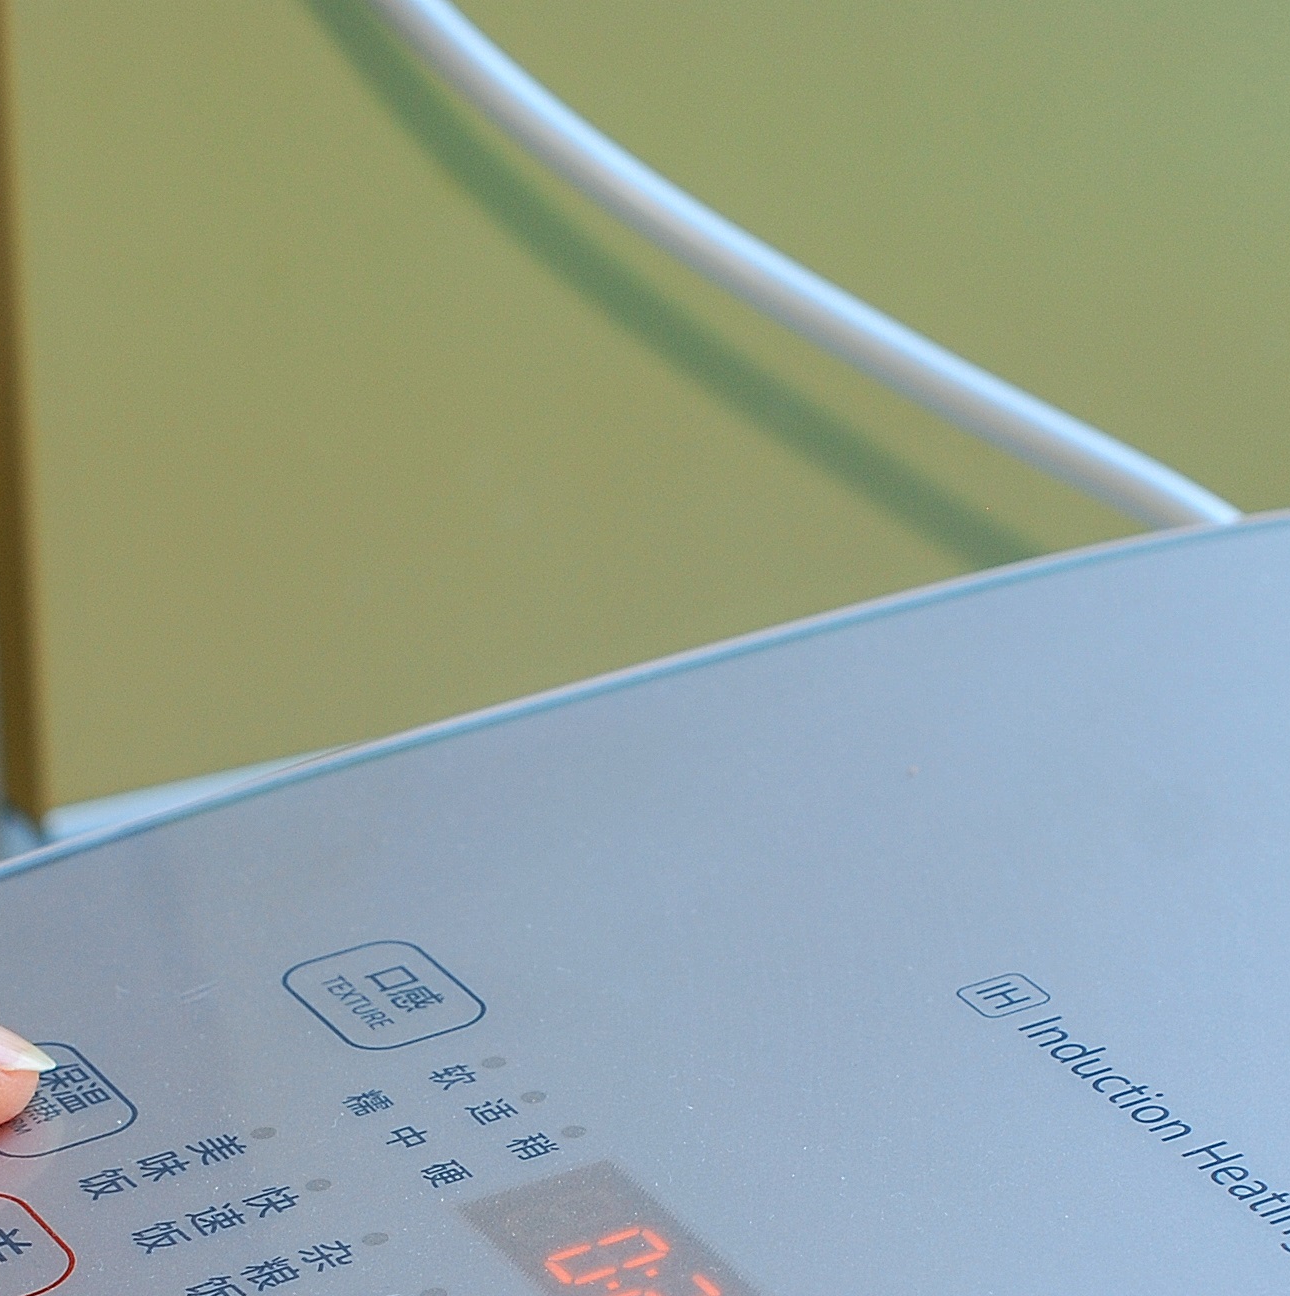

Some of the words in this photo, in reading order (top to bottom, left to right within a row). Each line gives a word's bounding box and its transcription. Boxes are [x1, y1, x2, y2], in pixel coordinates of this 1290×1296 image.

[322, 975, 396, 1031] TEXTURE
[367, 966, 444, 1013] 口感
[38, 1063, 112, 1114] 保温
[976, 982, 1031, 1009] IH
[1017, 1015, 1192, 1142] Induction
[84, 1134, 247, 1197] 美味饭
[133, 1187, 299, 1254] 快速饭
